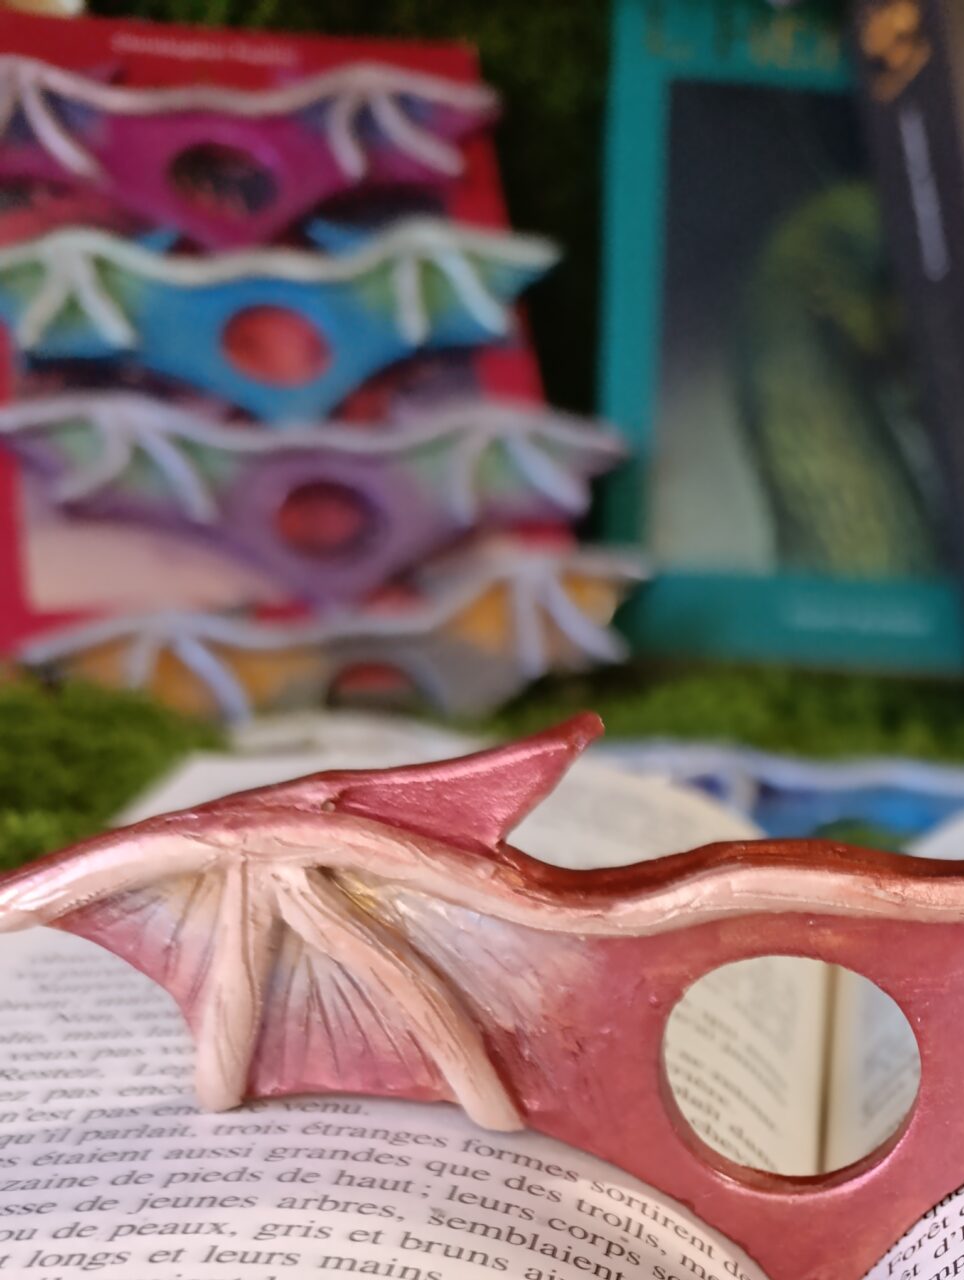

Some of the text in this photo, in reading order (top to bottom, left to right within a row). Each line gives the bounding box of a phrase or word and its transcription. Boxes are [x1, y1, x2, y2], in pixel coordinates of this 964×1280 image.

[80, 1105, 143, 1124] pas
[32, 1147, 153, 1168] étaient
[163, 1142, 257, 1161] aussi
[263, 1147, 413, 1168] grandes
[424, 1159, 492, 1181] que
[503, 1174, 563, 1204] des
[576, 1198, 668, 1257] trolls,
[73, 1194, 120, 1214] de
[126, 1192, 260, 1215] jeunes
[275, 1193, 406, 1223] arbres,
[109, 1169, 155, 1187] de
[160, 1166, 265, 1189] pieds
[275, 1166, 322, 1184] de
[331, 1168, 416, 1195] haut
[446, 1184, 536, 1222] leurs
[547, 1216, 642, 1267] corps
[211, 1120, 291, 1137] trois
[299, 1120, 450, 1149] étranges
[461, 1138, 580, 1184] formes
[590, 1178, 717, 1260] sortirent
[23, 1249, 132, 1272] longs
[147, 1247, 187, 1264] et
[200, 1244, 302, 1266] leurs
[51, 1220, 99, 1240] de
[105, 1220, 238, 1242] peaux,
[252, 1219, 334, 1241] gris
[347, 1228, 386, 1246] et
[398, 1230, 510, 1273] bruns
[887, 1216, 951, 1277] Forêt
